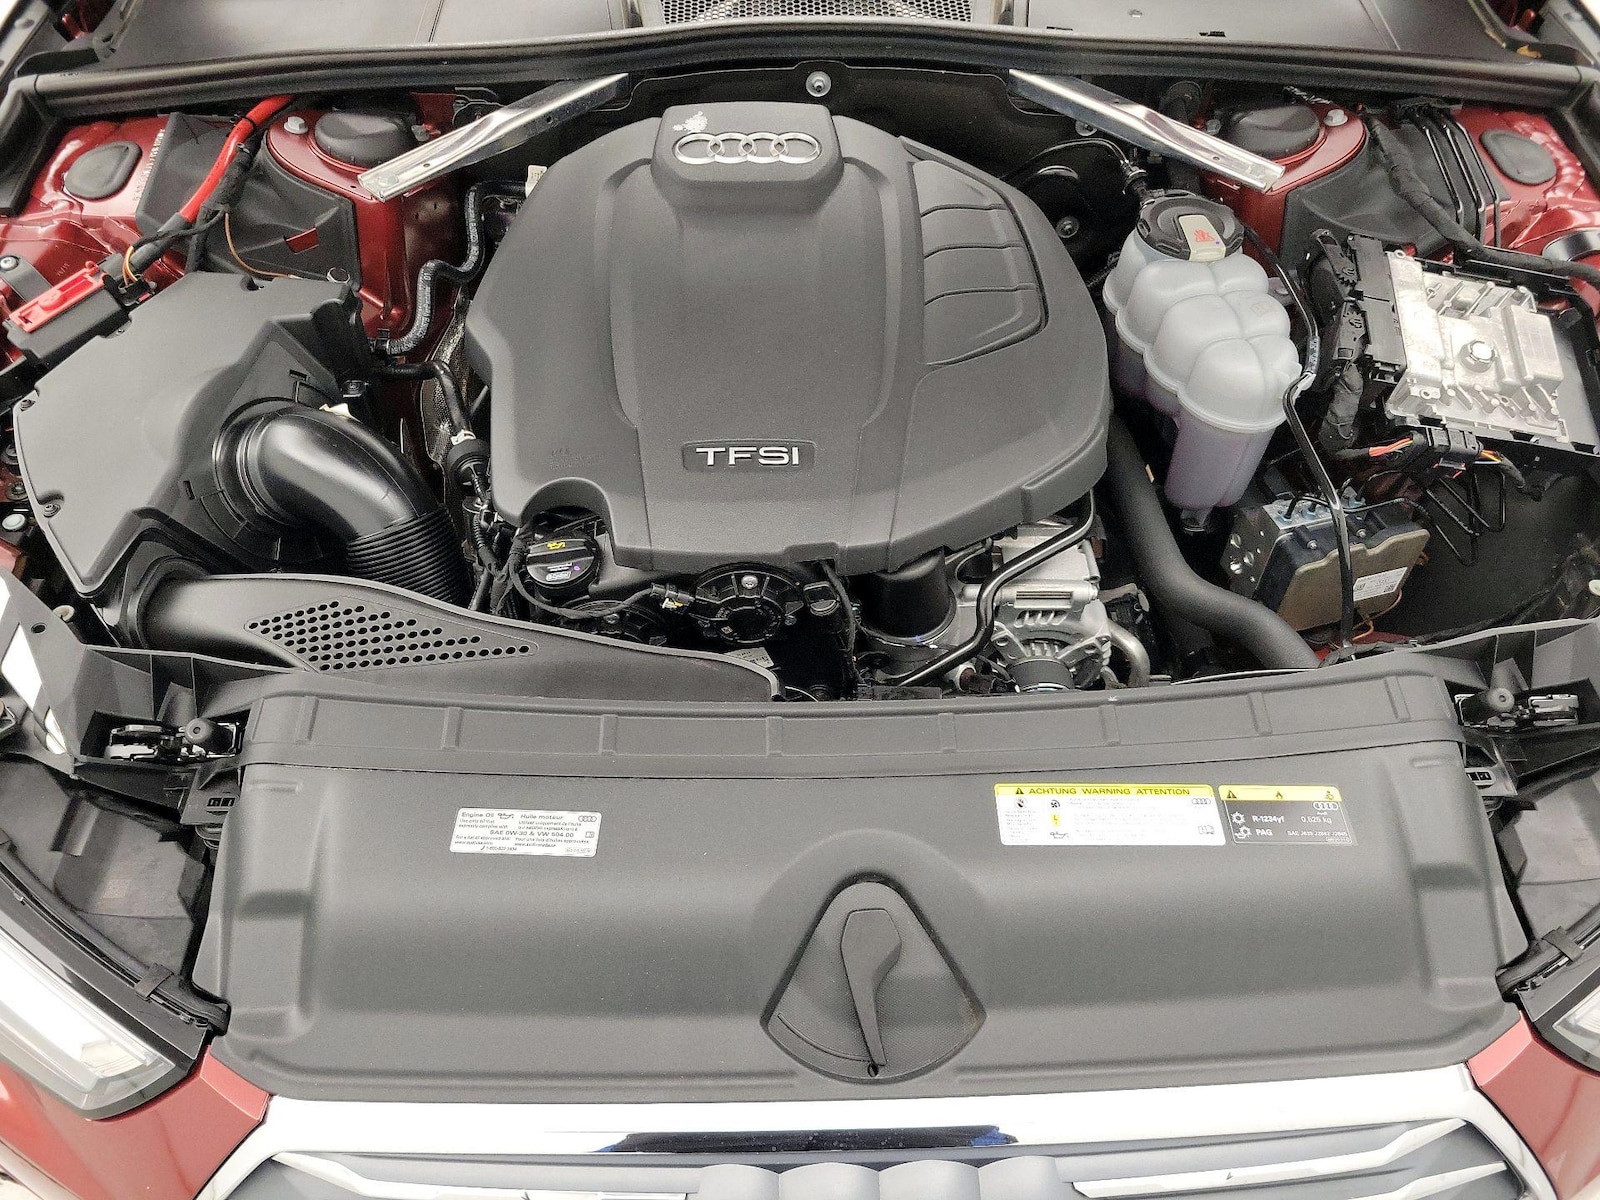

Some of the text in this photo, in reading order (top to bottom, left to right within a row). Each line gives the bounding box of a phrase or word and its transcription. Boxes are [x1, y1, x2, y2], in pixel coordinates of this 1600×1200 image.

[695, 446, 800, 466] TFSI
[1029, 787, 1190, 796] ACHTUNG WARNING ATTENTION
[1252, 816, 1285, 824] R-1234yf
